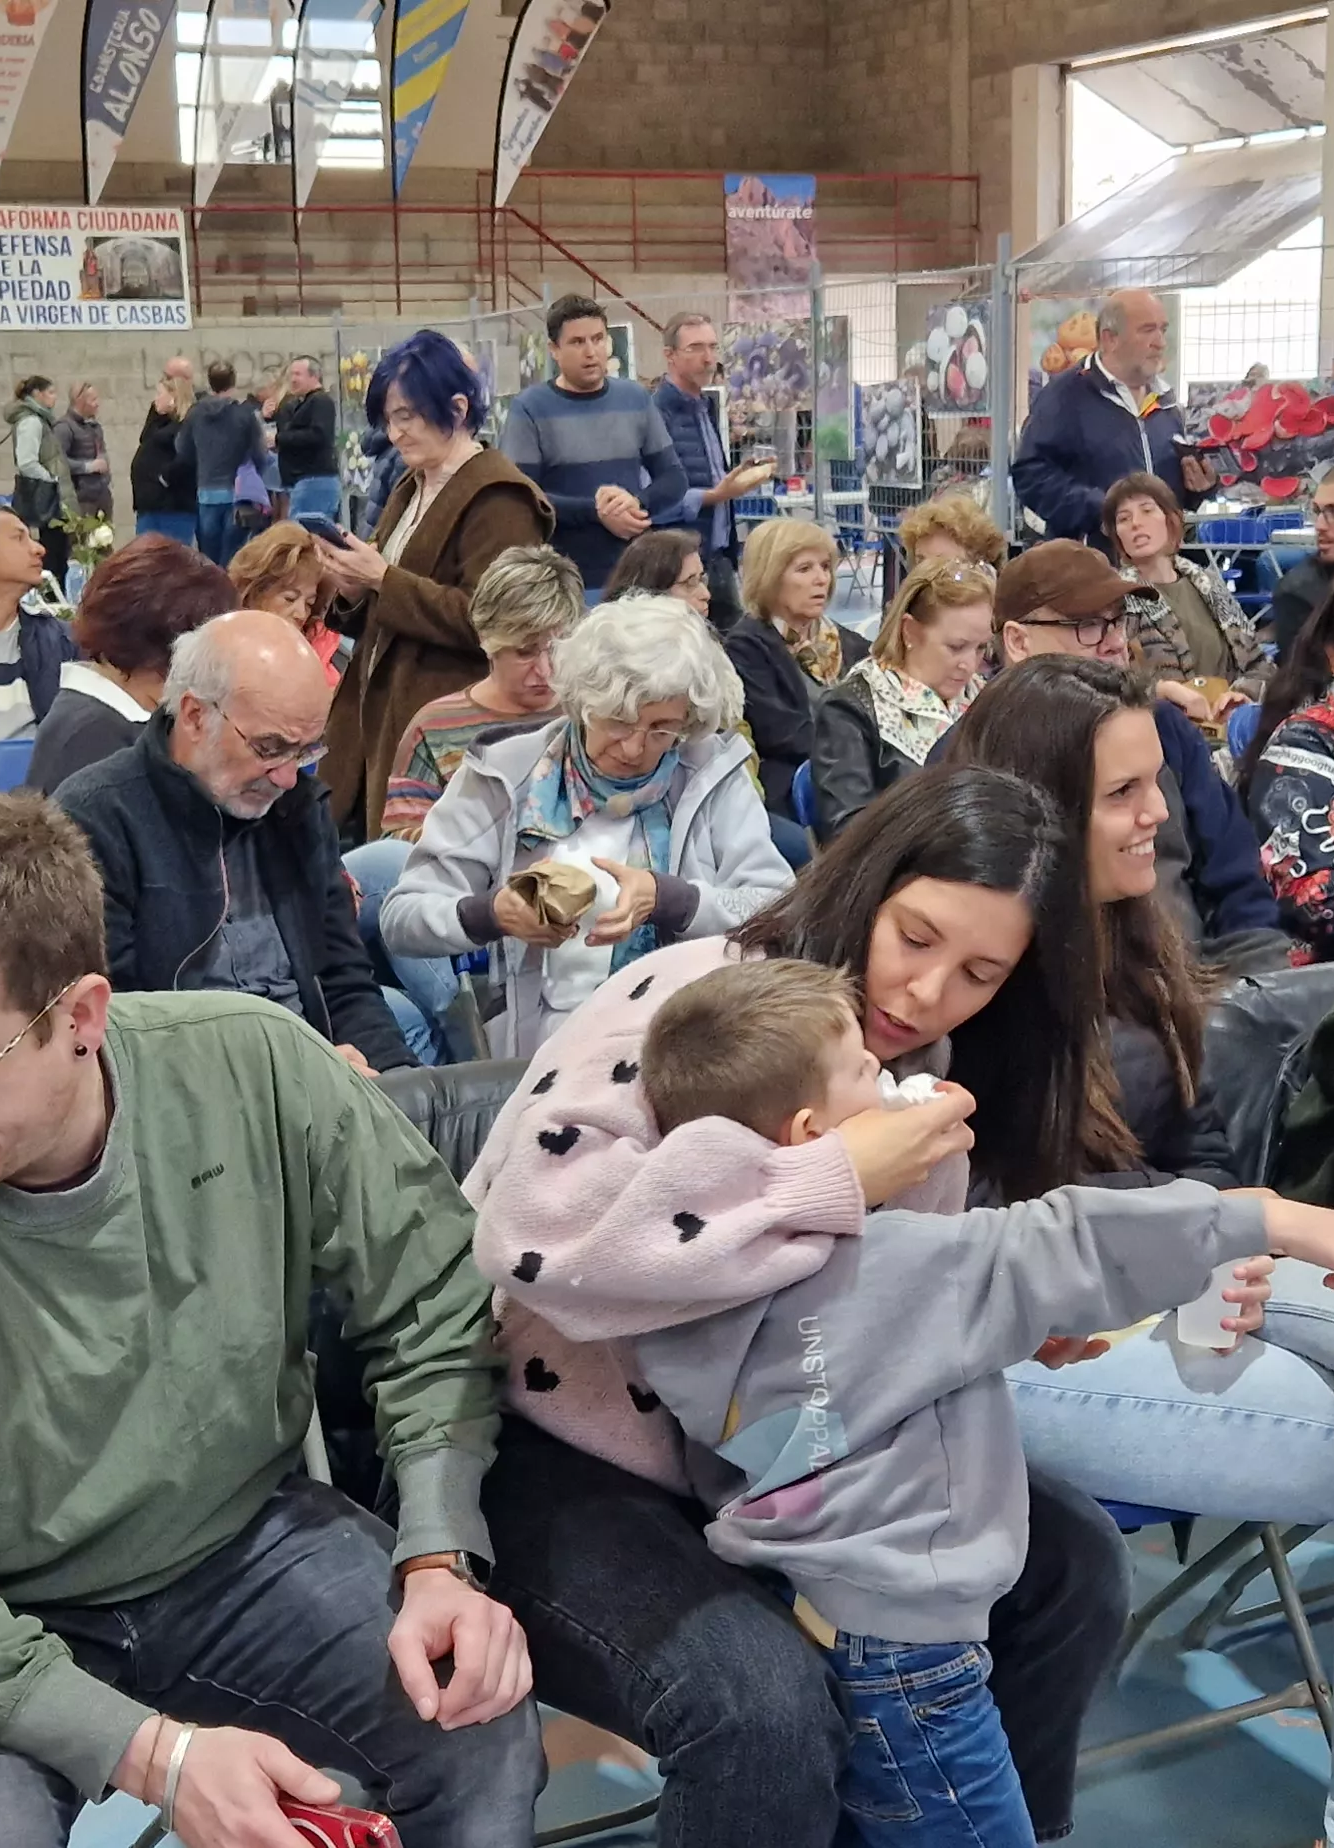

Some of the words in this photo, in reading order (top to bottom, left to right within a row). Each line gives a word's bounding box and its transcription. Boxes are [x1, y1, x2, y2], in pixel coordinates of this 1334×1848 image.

[103, 7, 161, 122] ALONSO
[727, 204, 813, 219] aventúrate
[77, 212, 179, 232] CIUDADANA
[18, 259, 42, 277] LA
[18, 304, 83, 325] VIRGEN
[89, 305, 112, 325] DE
[117, 305, 186, 325] CASBAS
